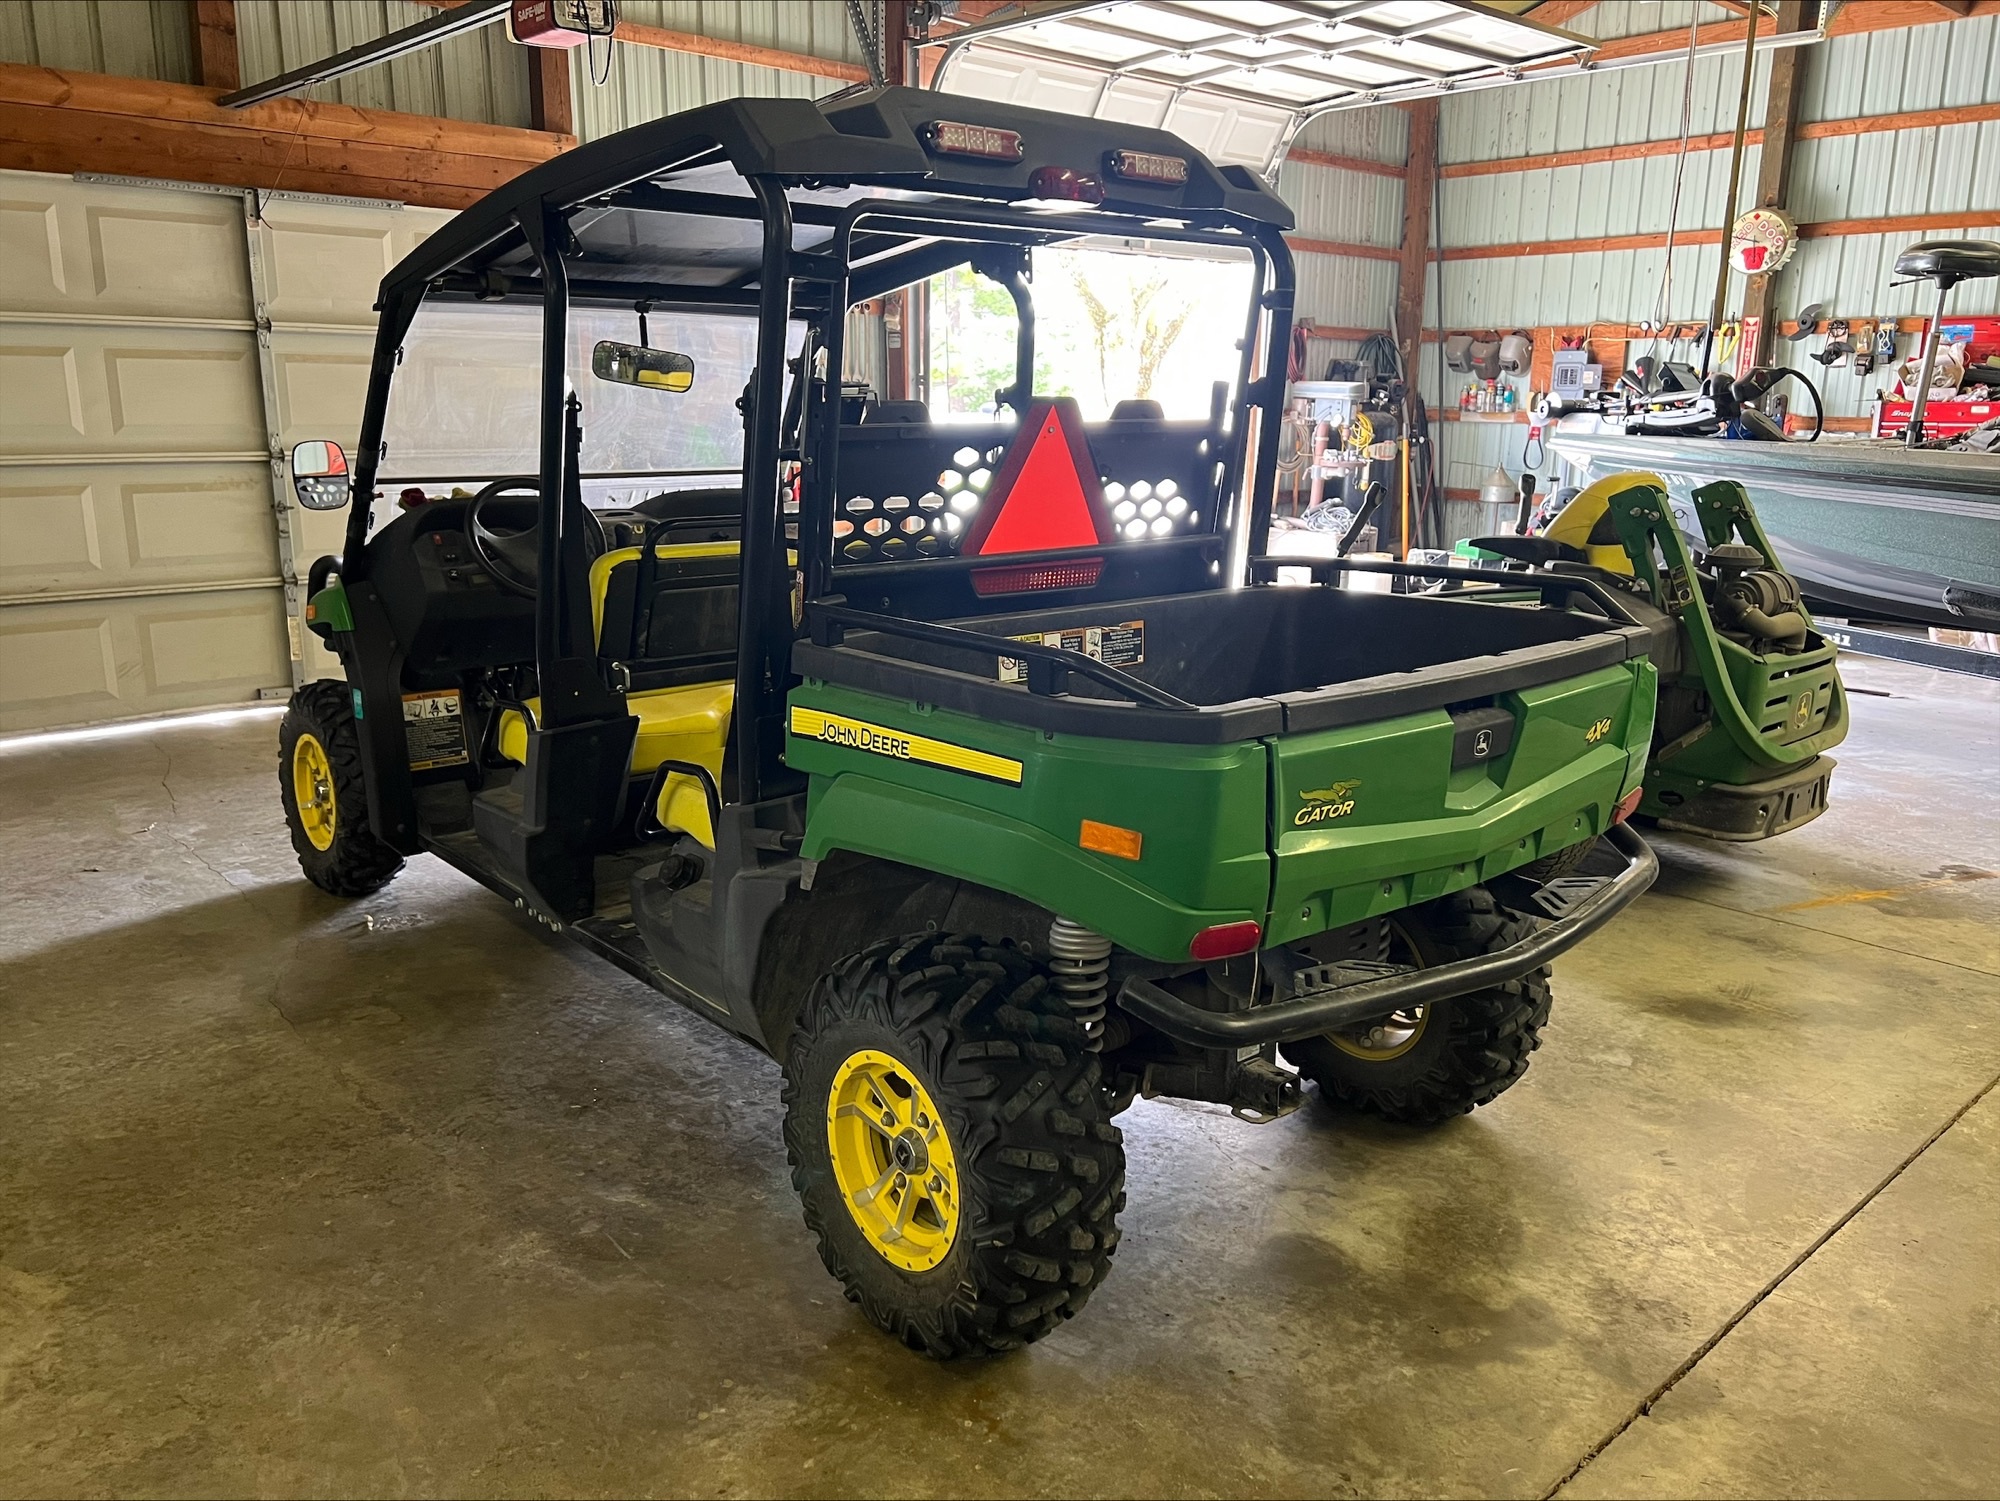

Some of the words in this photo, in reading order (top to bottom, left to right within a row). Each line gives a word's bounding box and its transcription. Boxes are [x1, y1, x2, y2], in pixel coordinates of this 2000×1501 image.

[517, 1, 547, 22] SAFE-WAY
[1757, 220, 1785, 246] DOG
[818, 719, 857, 746] JOHN
[859, 727, 910, 758] DEERE
[1294, 800, 1355, 826] GATOR
